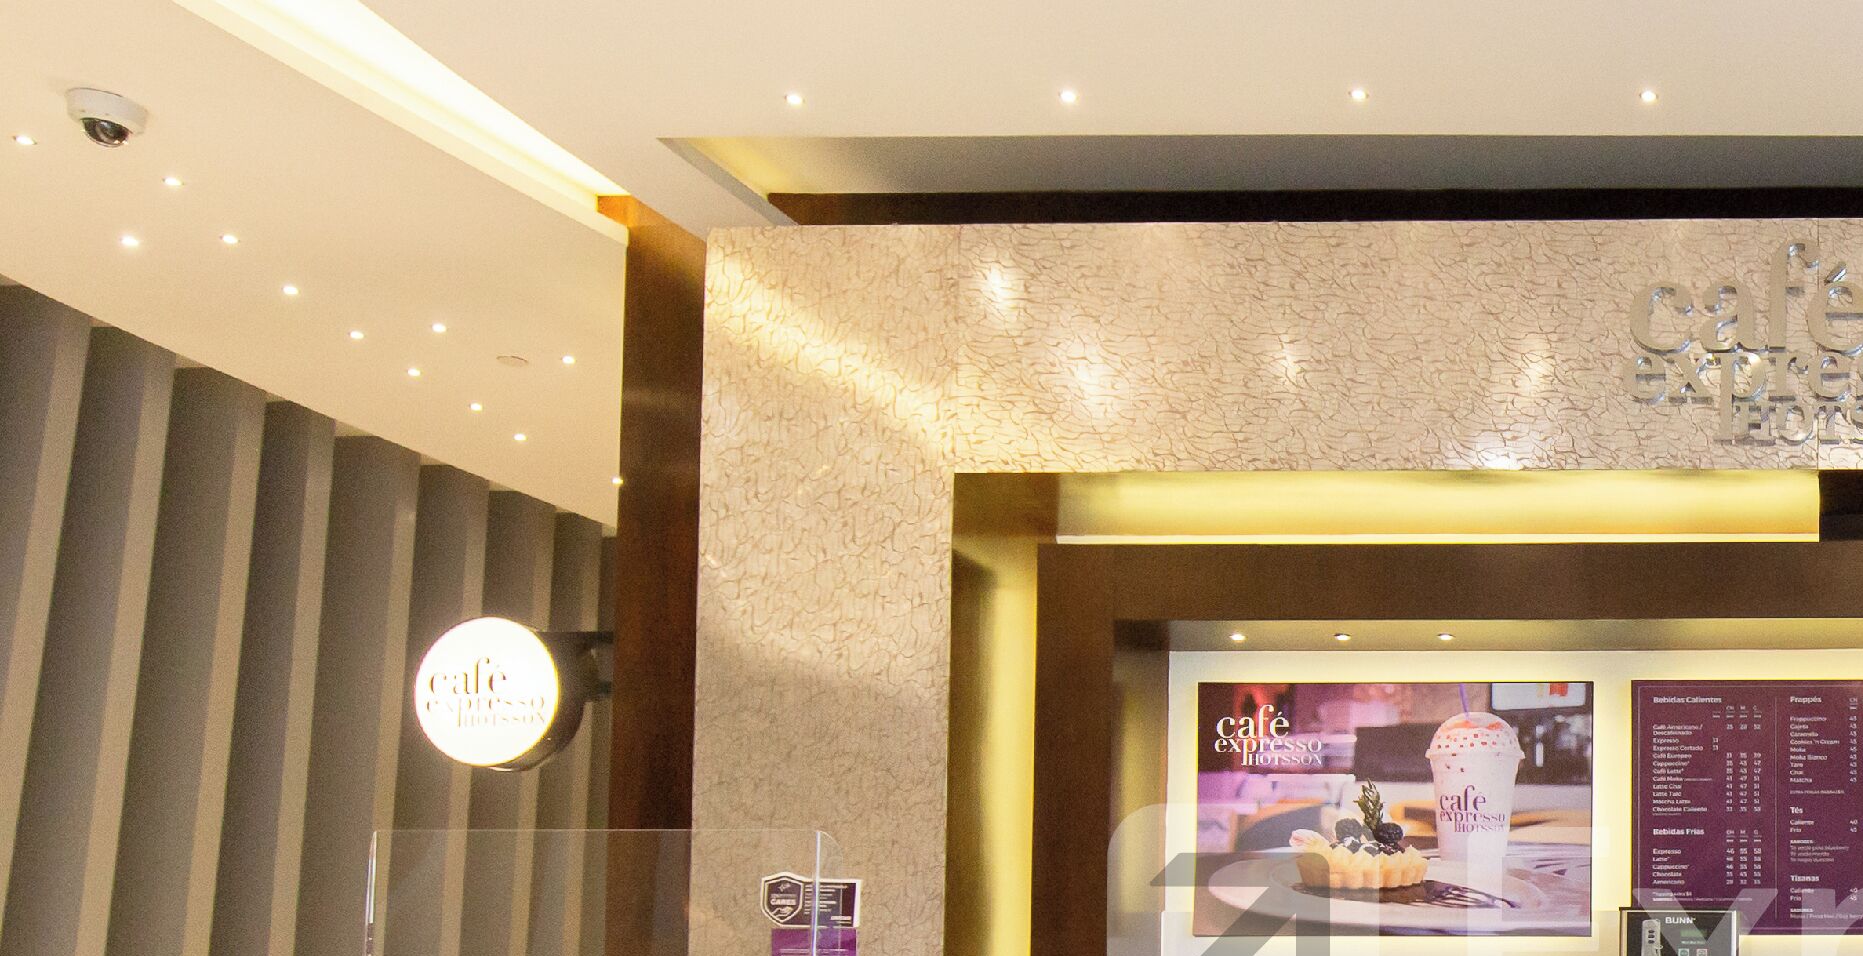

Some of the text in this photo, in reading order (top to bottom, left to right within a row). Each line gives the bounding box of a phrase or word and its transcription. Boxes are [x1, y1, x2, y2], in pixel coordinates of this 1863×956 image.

[1653, 696, 1685, 704] Bebidas
[1790, 696, 1822, 704] Frappés
[1216, 703, 1290, 740] café
[1214, 737, 1323, 766] expresso
[1439, 784, 1487, 812] café
[1790, 806, 1803, 814] Tés
